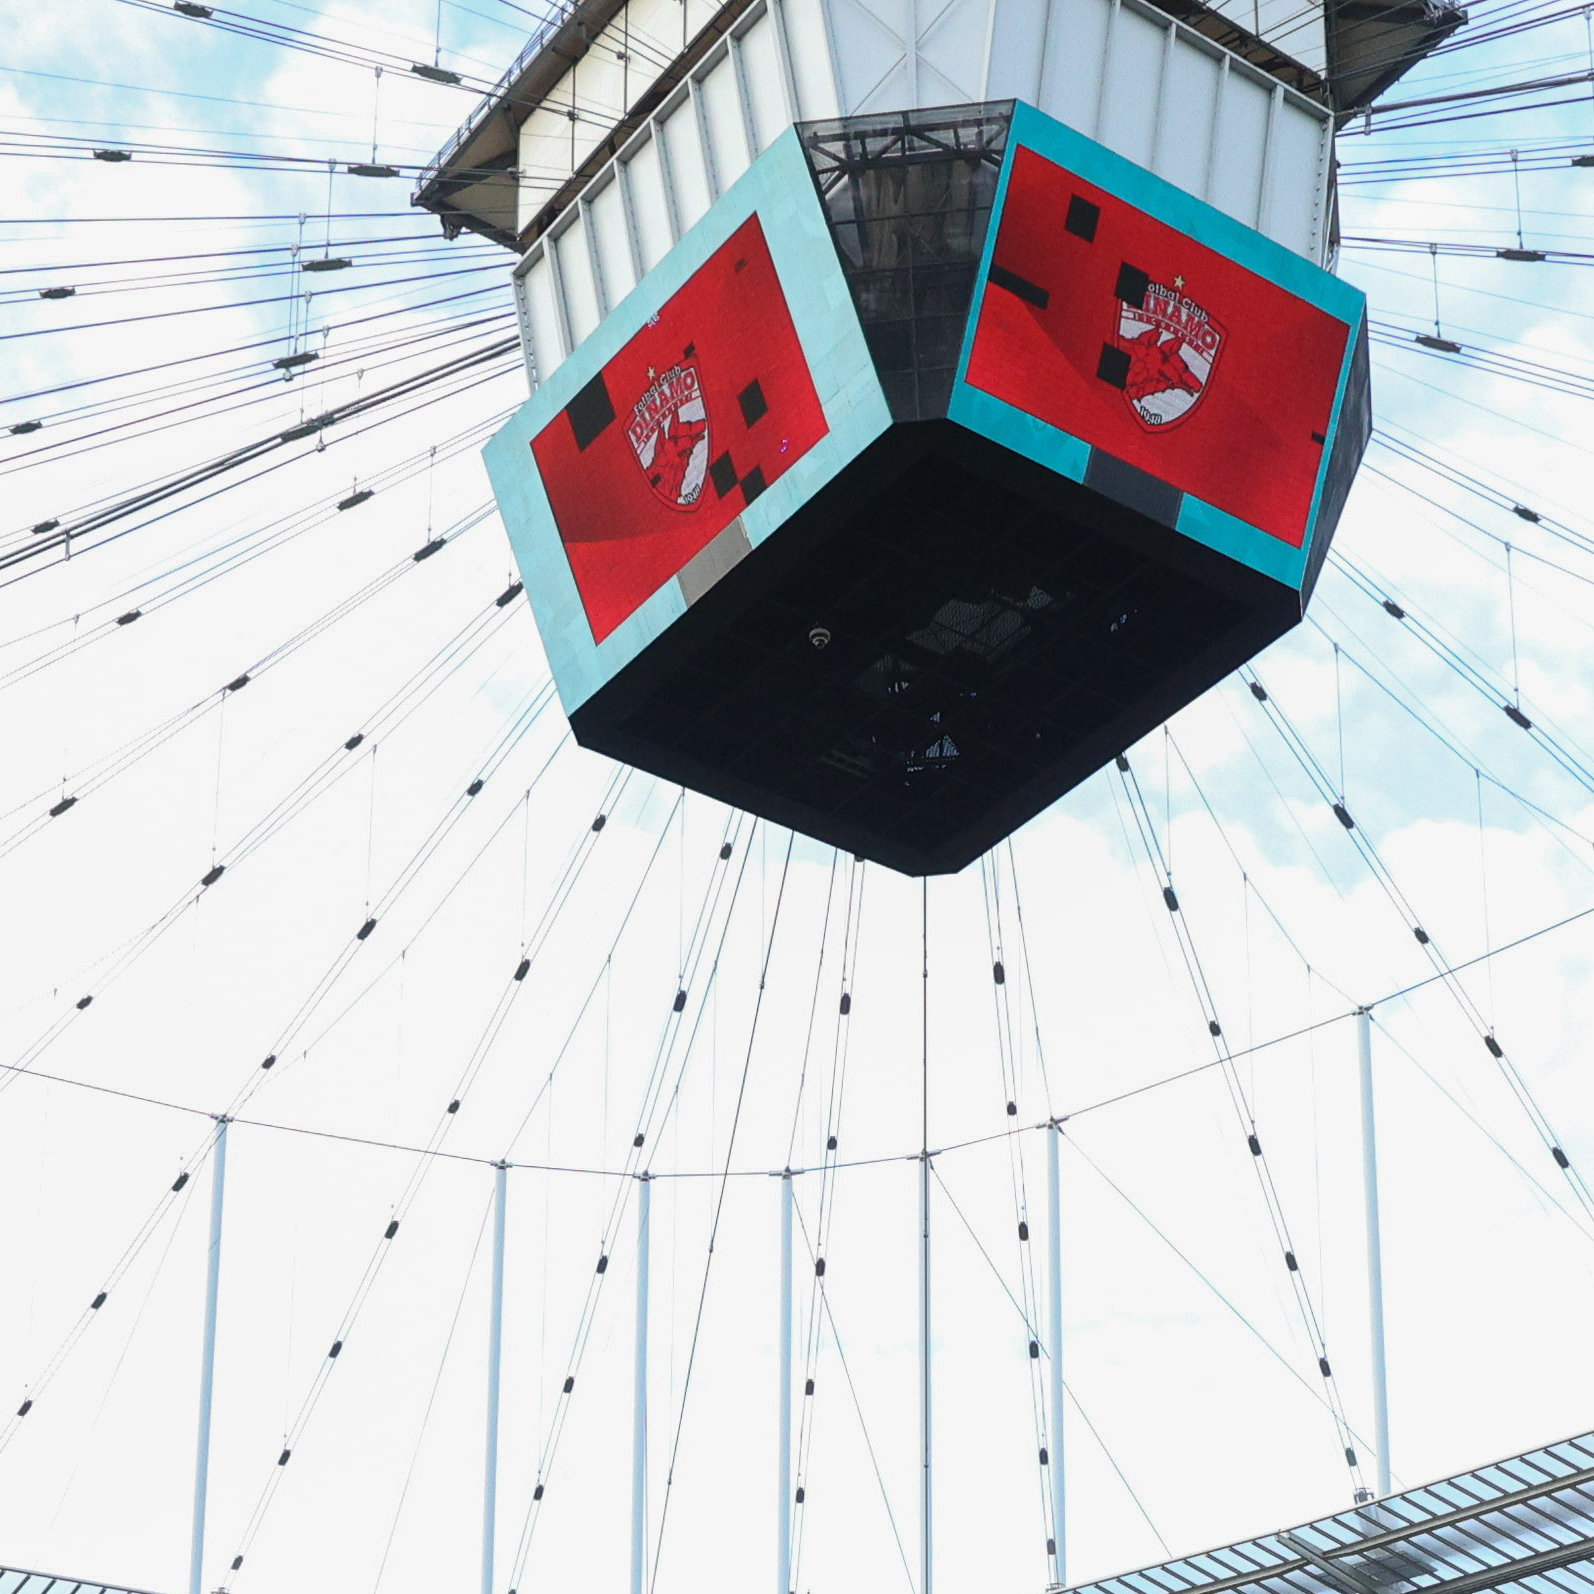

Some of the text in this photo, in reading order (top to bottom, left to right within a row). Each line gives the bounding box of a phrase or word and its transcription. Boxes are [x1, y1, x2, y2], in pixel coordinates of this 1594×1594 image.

[1143, 292, 1217, 351] INAMO
[1148, 283, 1209, 322] otbal Club
[659, 365, 682, 386] Club
[630, 370, 697, 443] DINAMO
